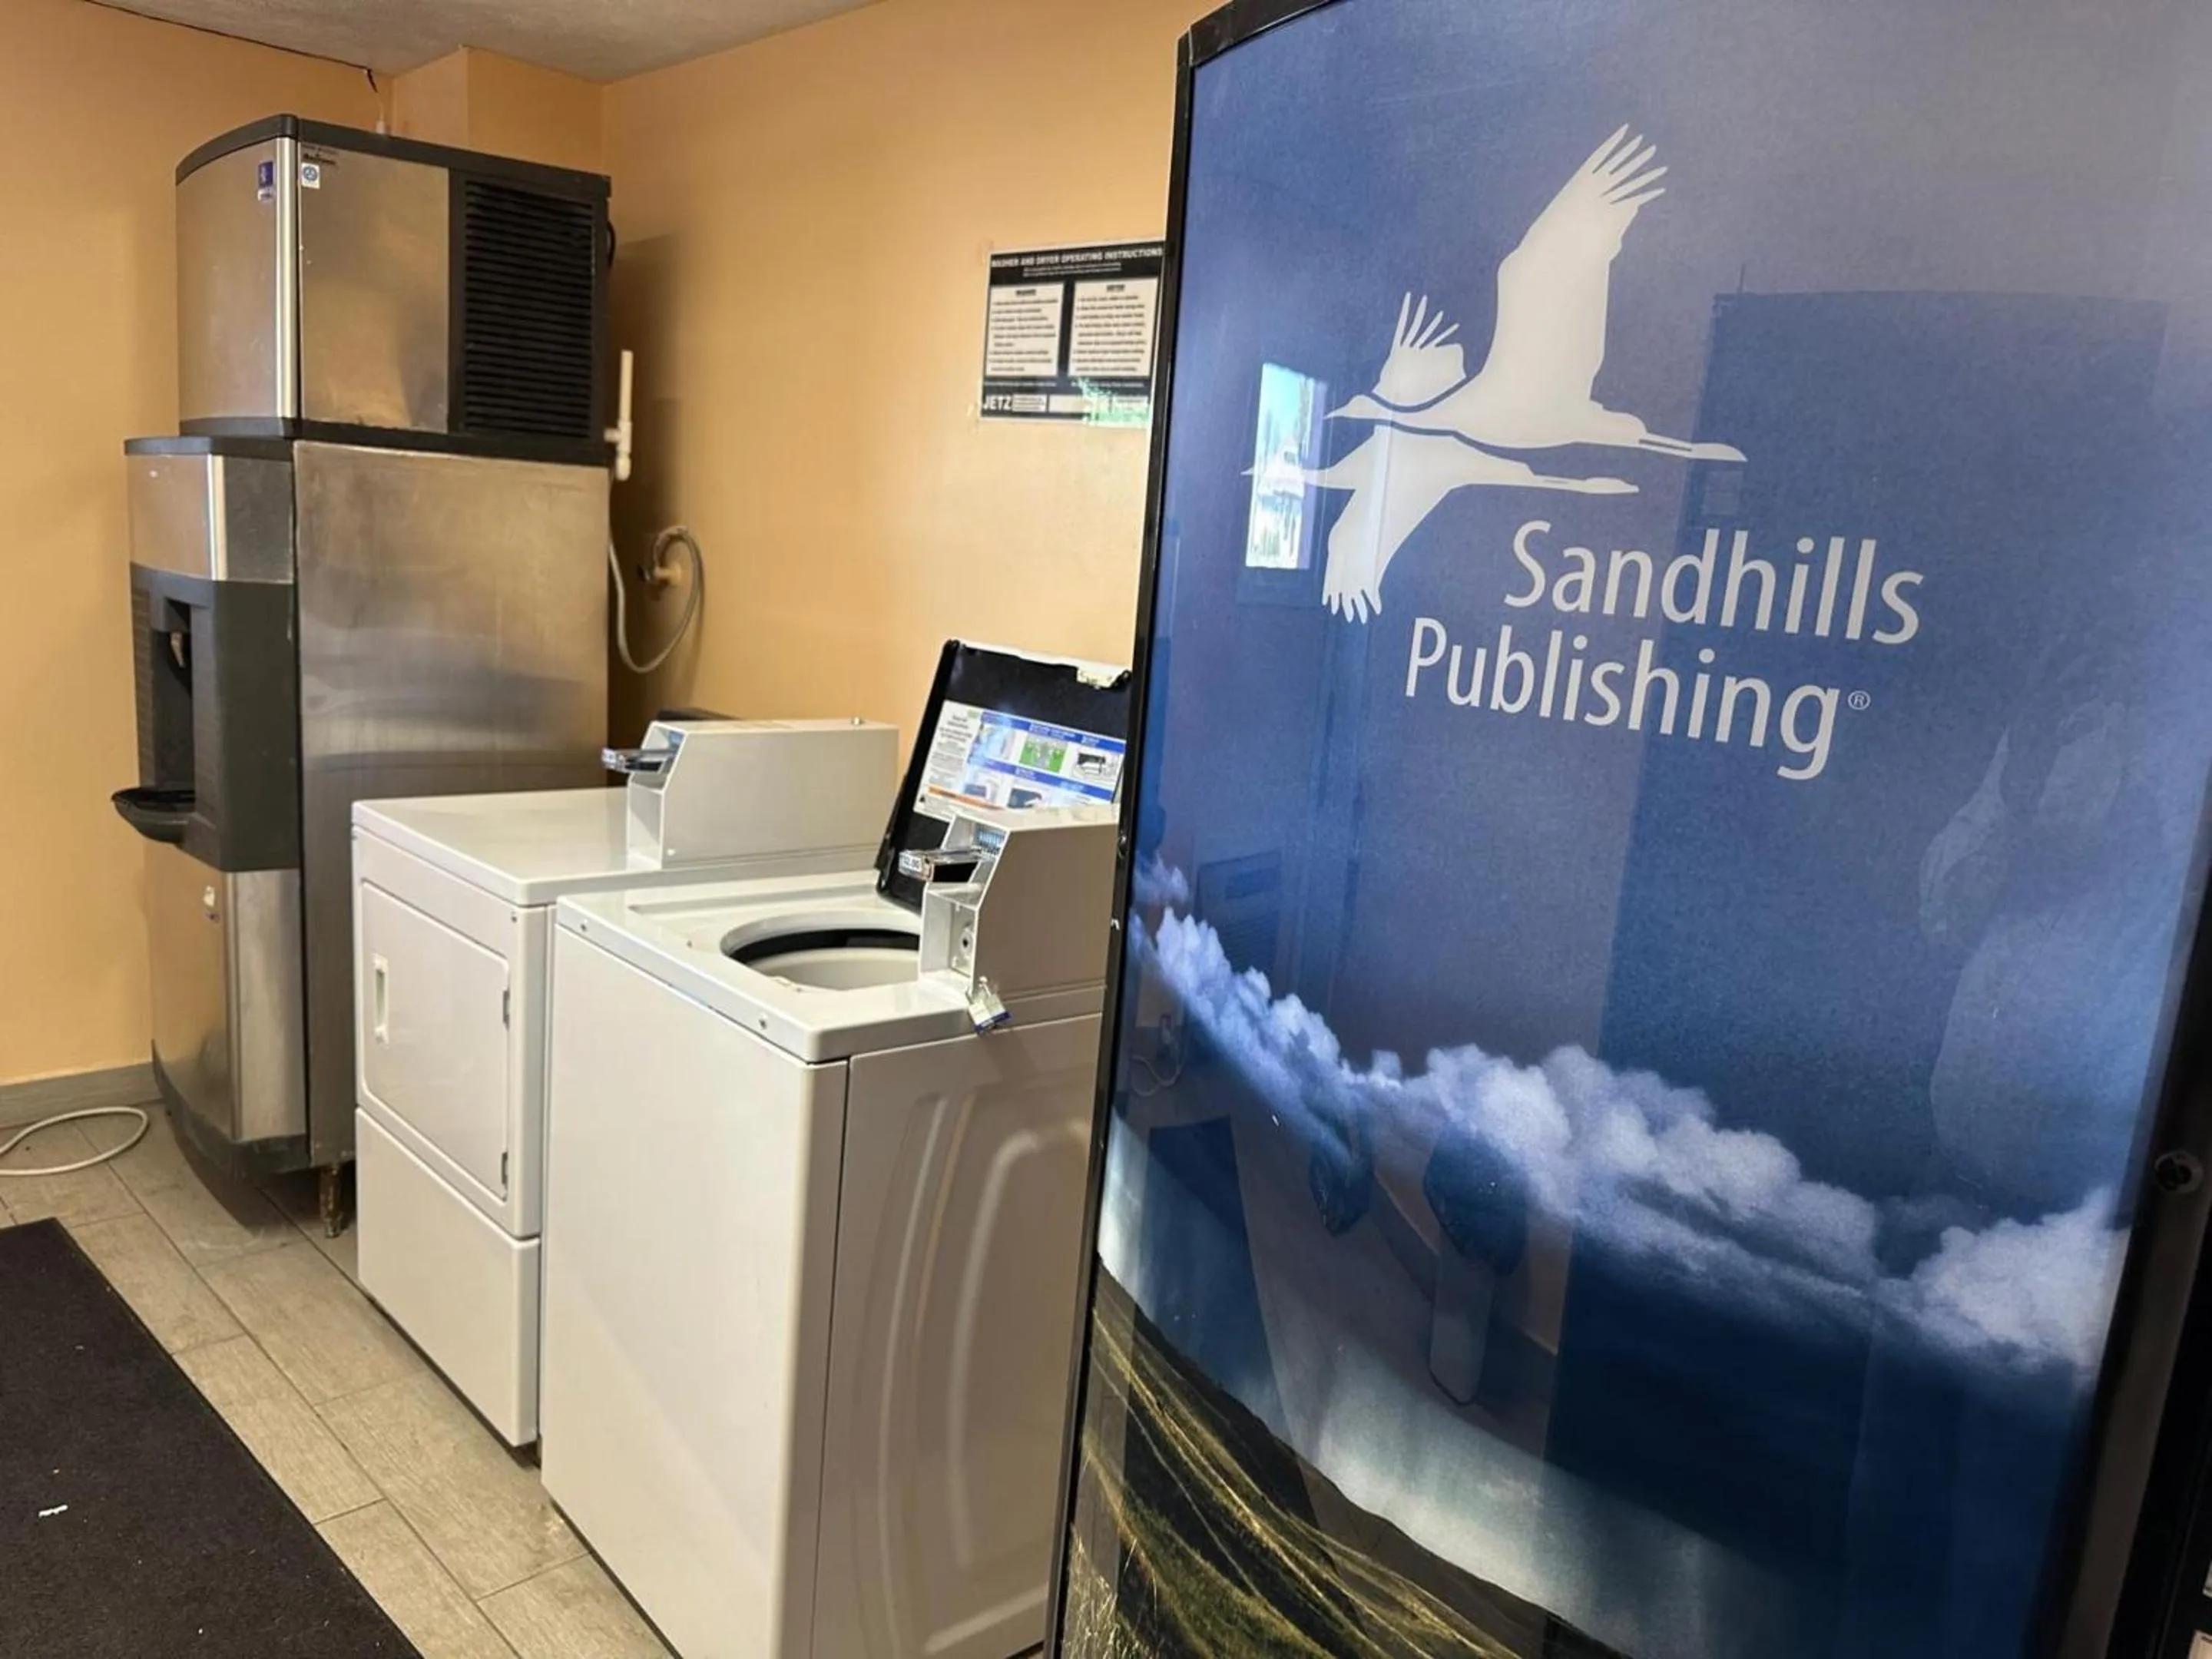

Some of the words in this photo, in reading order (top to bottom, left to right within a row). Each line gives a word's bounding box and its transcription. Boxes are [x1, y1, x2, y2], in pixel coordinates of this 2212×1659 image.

[1021, 257, 1035, 266] AND
[1061, 253, 1103, 263] OPERATING
[1104, 247, 1163, 259] INSTRUCTIONS
[982, 394, 1012, 411] JETZ
[1503, 519, 1924, 644] Sandhills
